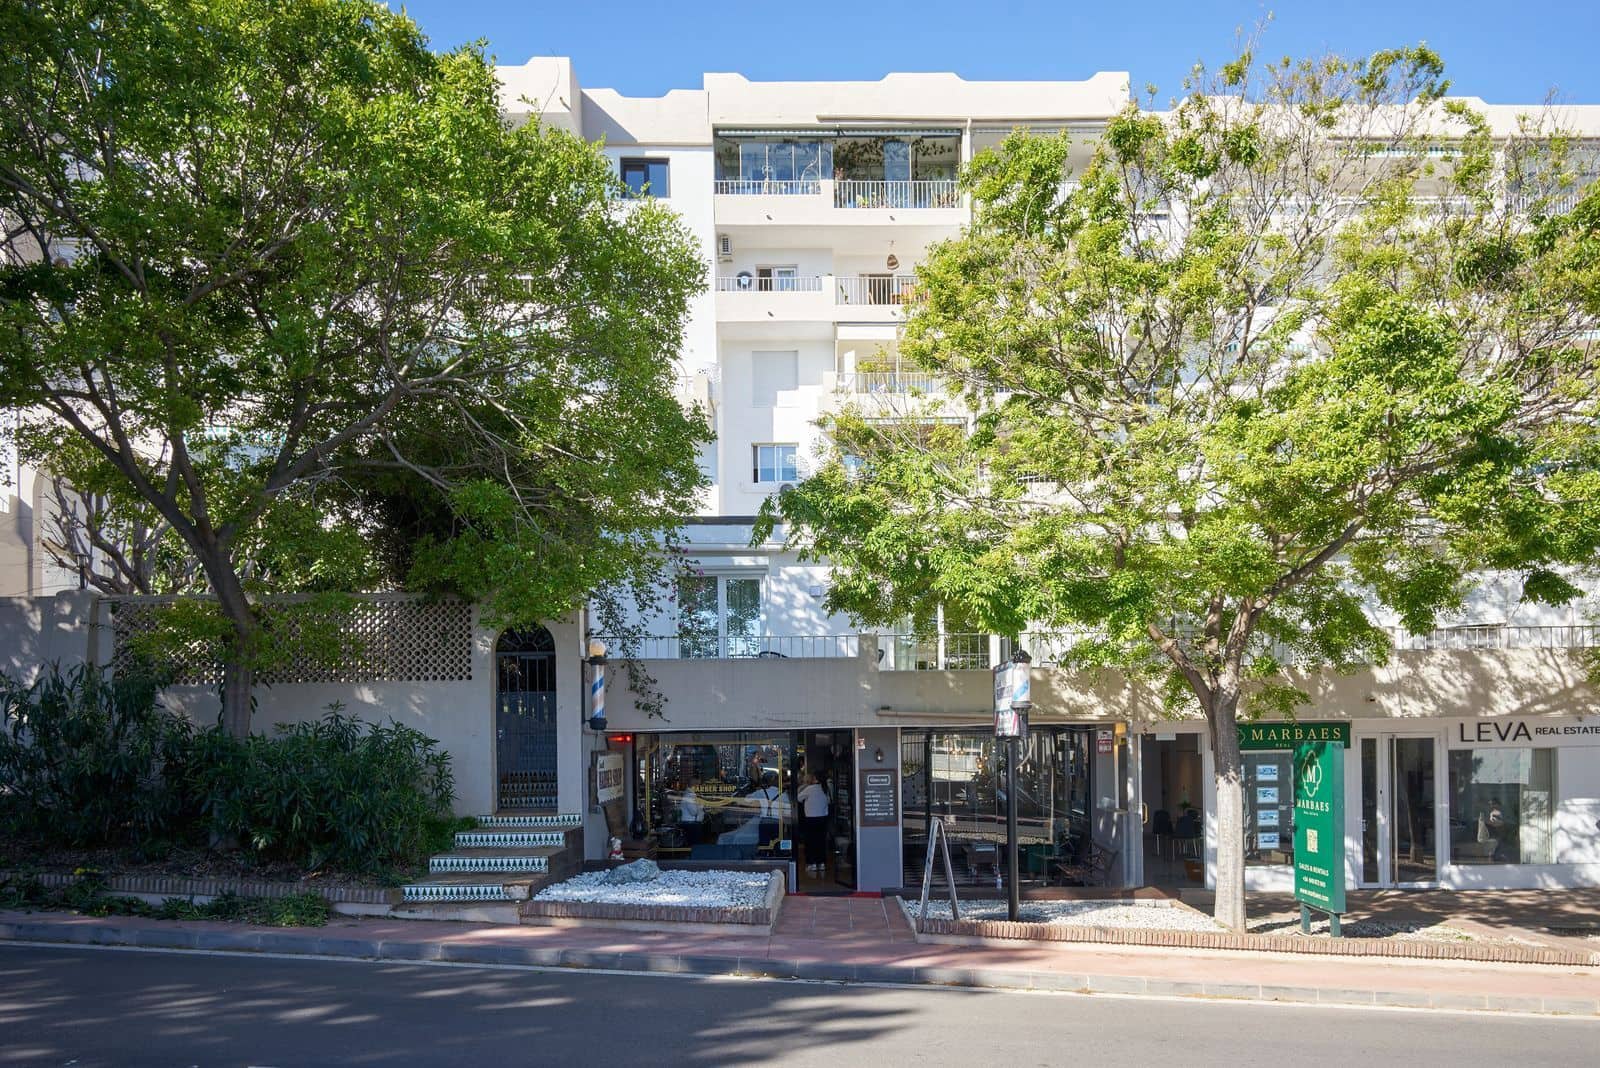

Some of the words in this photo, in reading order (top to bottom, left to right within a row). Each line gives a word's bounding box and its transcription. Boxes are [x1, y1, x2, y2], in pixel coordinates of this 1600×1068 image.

[1251, 727, 1341, 741] MARBAES
[1459, 721, 1532, 742] LEVA
[1535, 727, 1562, 736] REAL
[1564, 726, 1600, 735] ESTATE
[1296, 798, 1330, 813] MARBAES
